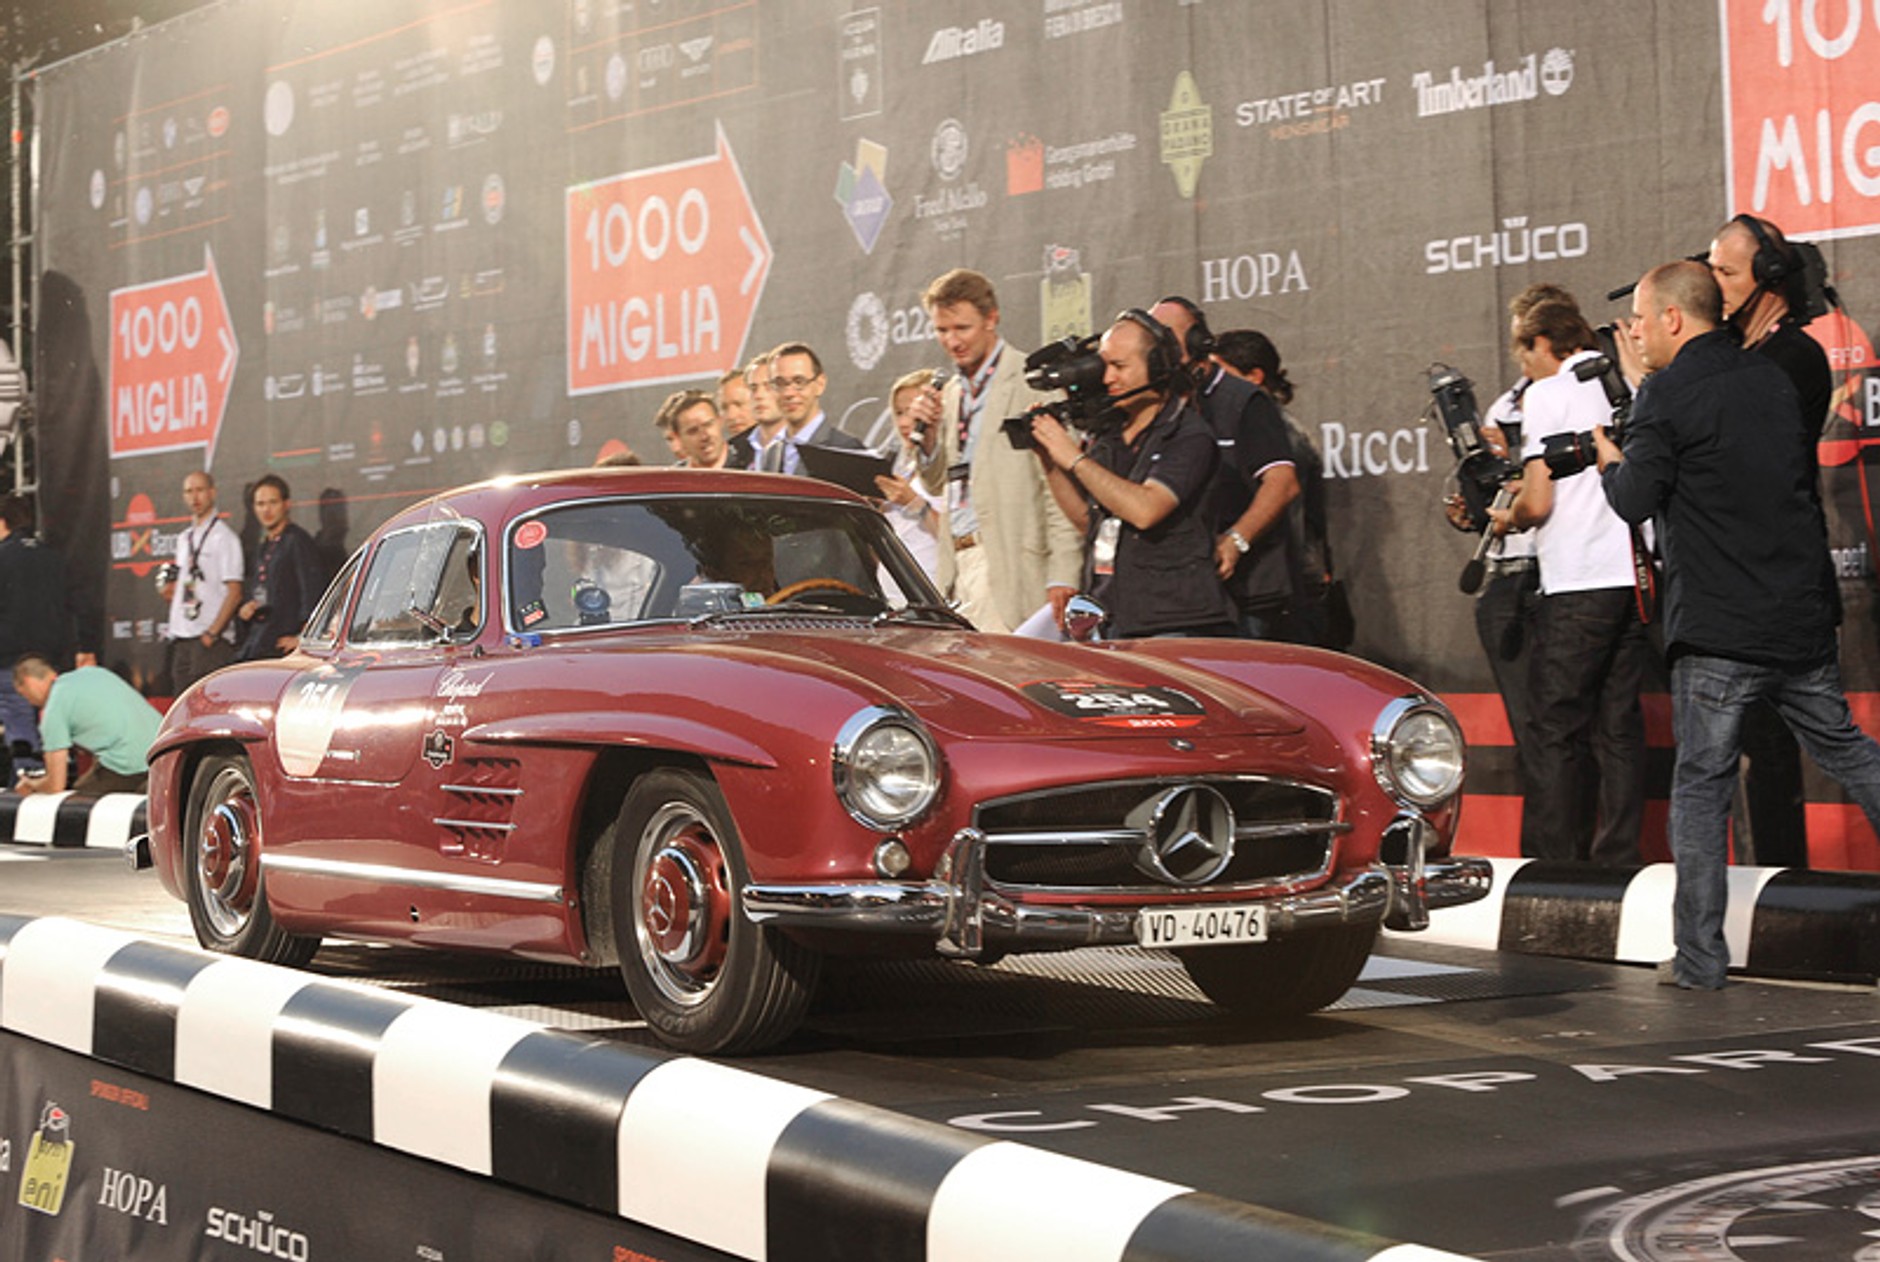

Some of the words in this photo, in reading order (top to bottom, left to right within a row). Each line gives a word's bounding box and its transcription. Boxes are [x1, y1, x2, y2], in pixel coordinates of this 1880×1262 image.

[921, 18, 1004, 64] Alitalia
[1763, 0, 1880, 67] 10
[1236, 92, 1312, 126] STATE
[1337, 78, 1386, 109] ART
[1412, 53, 1538, 117] Timberland
[585, 188, 709, 272] 1000
[1425, 216, 1588, 274] SCHÜCO
[1202, 249, 1310, 302] HOPA
[120, 296, 202, 361] 1000
[579, 284, 720, 371] MIGLIA
[116, 373, 208, 438] MIGLIA
[1060, 693, 1170, 709] 254
[98, 1167, 168, 1225] HOPA
[205, 1207, 308, 1262] SCHÜCO
